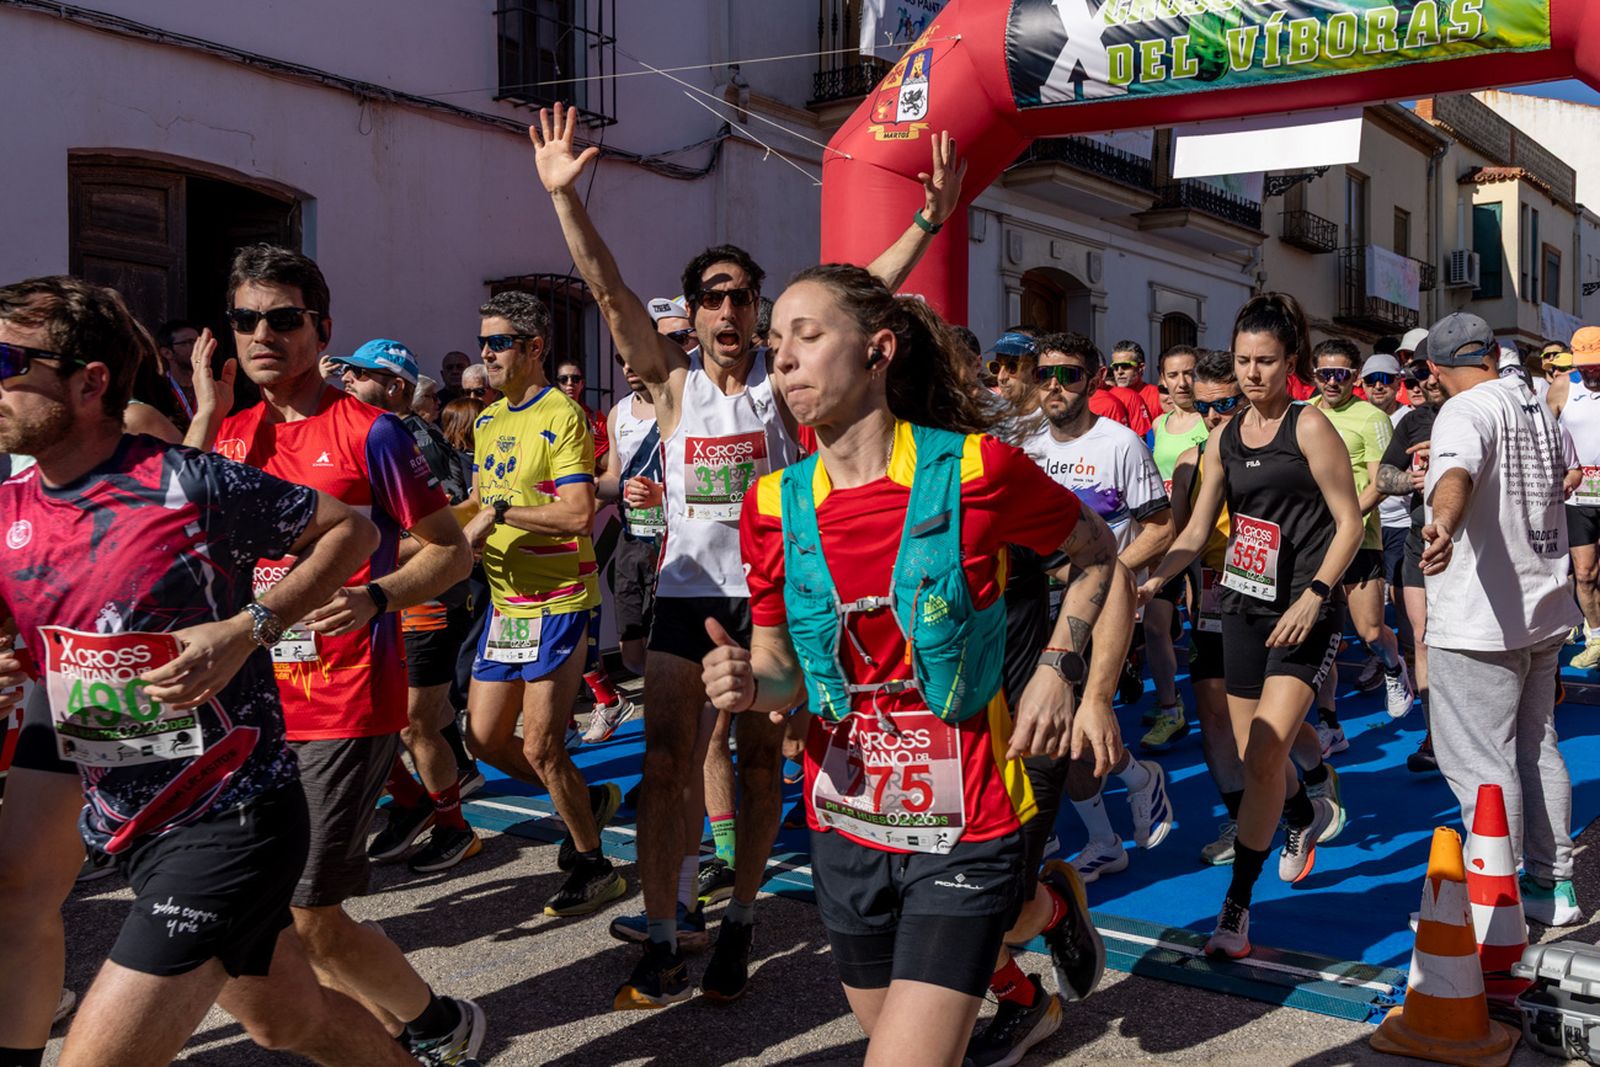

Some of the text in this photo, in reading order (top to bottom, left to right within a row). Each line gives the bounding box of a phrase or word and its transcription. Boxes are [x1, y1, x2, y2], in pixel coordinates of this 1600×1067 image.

[1106, 35, 1198, 86] DEL
[1222, 0, 1484, 72] VÍBORAS
[706, 441, 753, 457] CROSS
[693, 455, 744, 466] PANTANO
[1246, 460, 1260, 468] FILA
[696, 463, 754, 496] 317
[1244, 525, 1272, 542] CROSS
[1232, 540, 1268, 574] 555
[60, 635, 151, 668] X CROSS
[60, 662, 134, 683] PANTANO
[859, 728, 931, 750] CROSS
[825, 800, 855, 816] PILAR
[152, 896, 217, 922] sube corre
